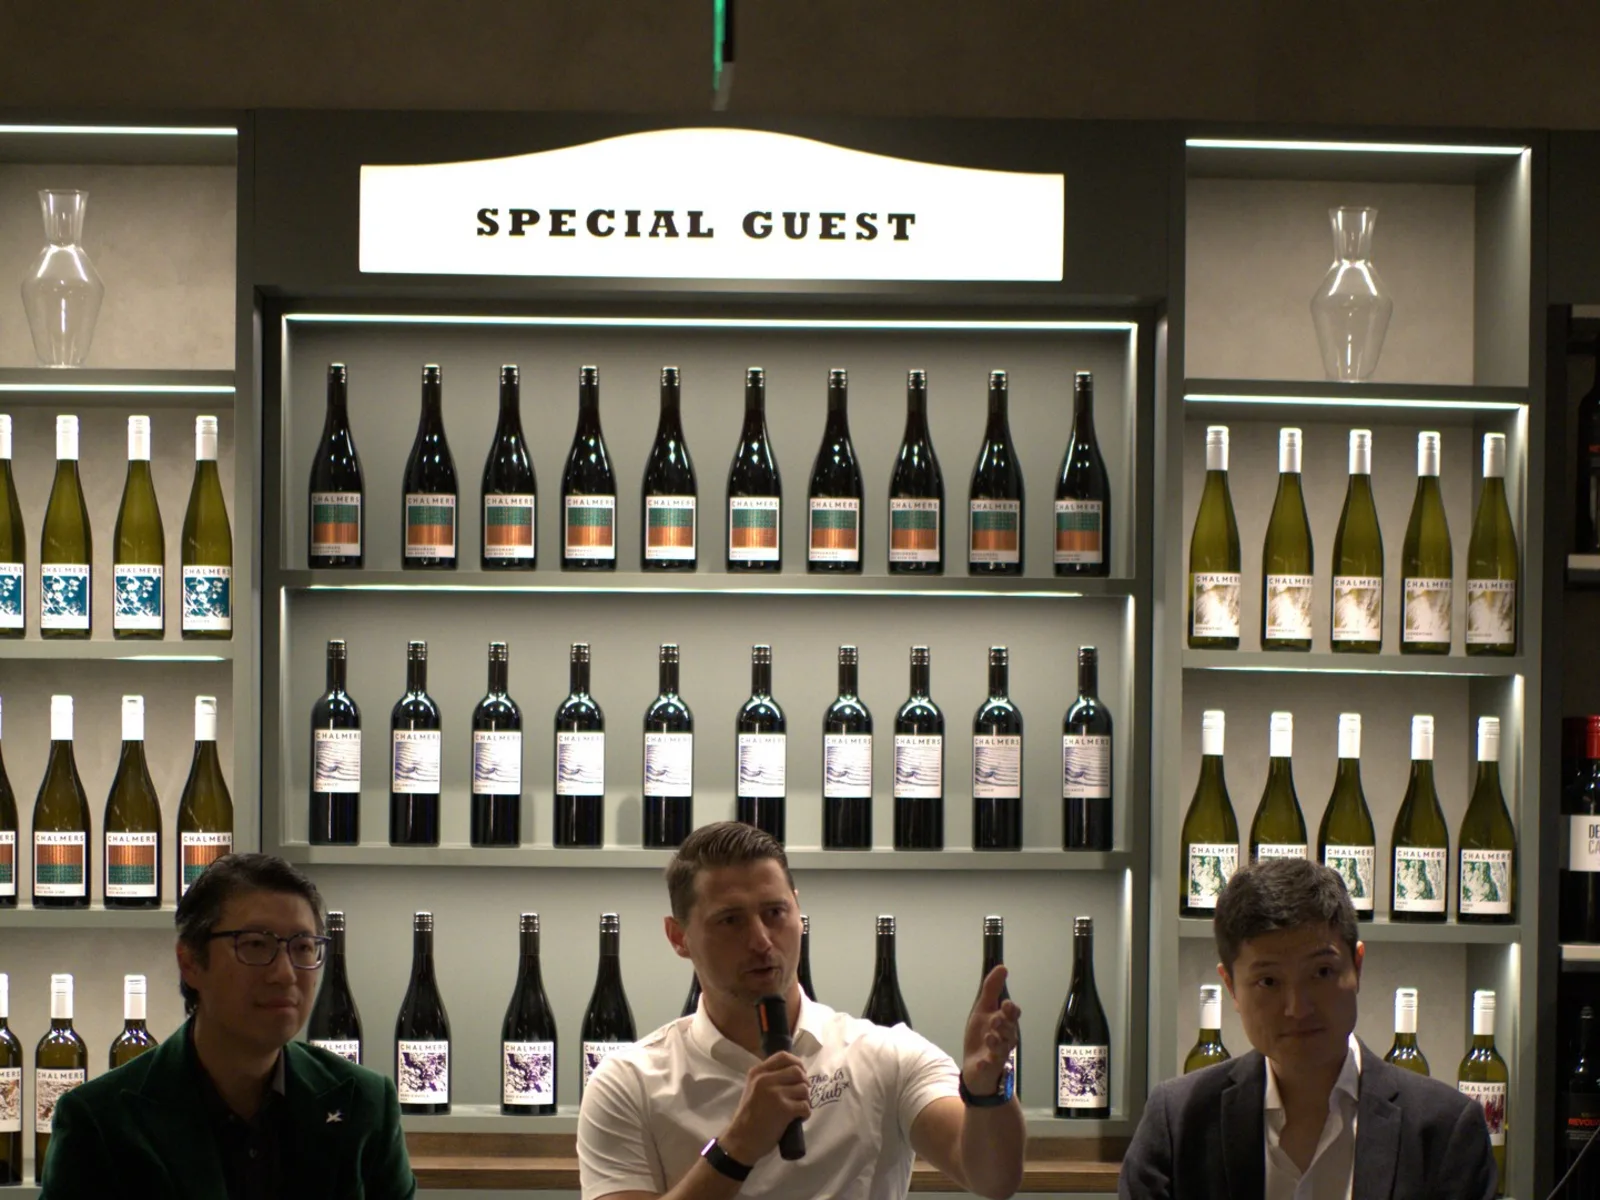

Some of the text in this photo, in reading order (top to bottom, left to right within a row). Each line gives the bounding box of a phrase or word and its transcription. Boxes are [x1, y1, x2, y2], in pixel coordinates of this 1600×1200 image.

[477, 208, 915, 241] SPECIAL GUEST
[312, 495, 360, 504] CHALMERS
[407, 497, 455, 505] CHALMERS
[486, 498, 534, 506] CHALMERS
[566, 499, 615, 507] CHALMERS
[647, 499, 696, 507] CHALMERS
[731, 500, 779, 508] CHALMERS
[811, 501, 859, 509] CHALMERS
[891, 502, 938, 510] CHALMERS
[971, 503, 1020, 511] CHALMERS
[1055, 503, 1102, 511] CHALMERS
[896, 738, 941, 746] CHALMERS
[974, 738, 1021, 746] CHALMERS
[36, 834, 84, 842] CHALMERS
[107, 835, 156, 844] CHALMERS
[183, 836, 232, 844] CHALMERS
[400, 1044, 447, 1052] CHALMERS
[37, 1071, 84, 1080] CHALMERS
